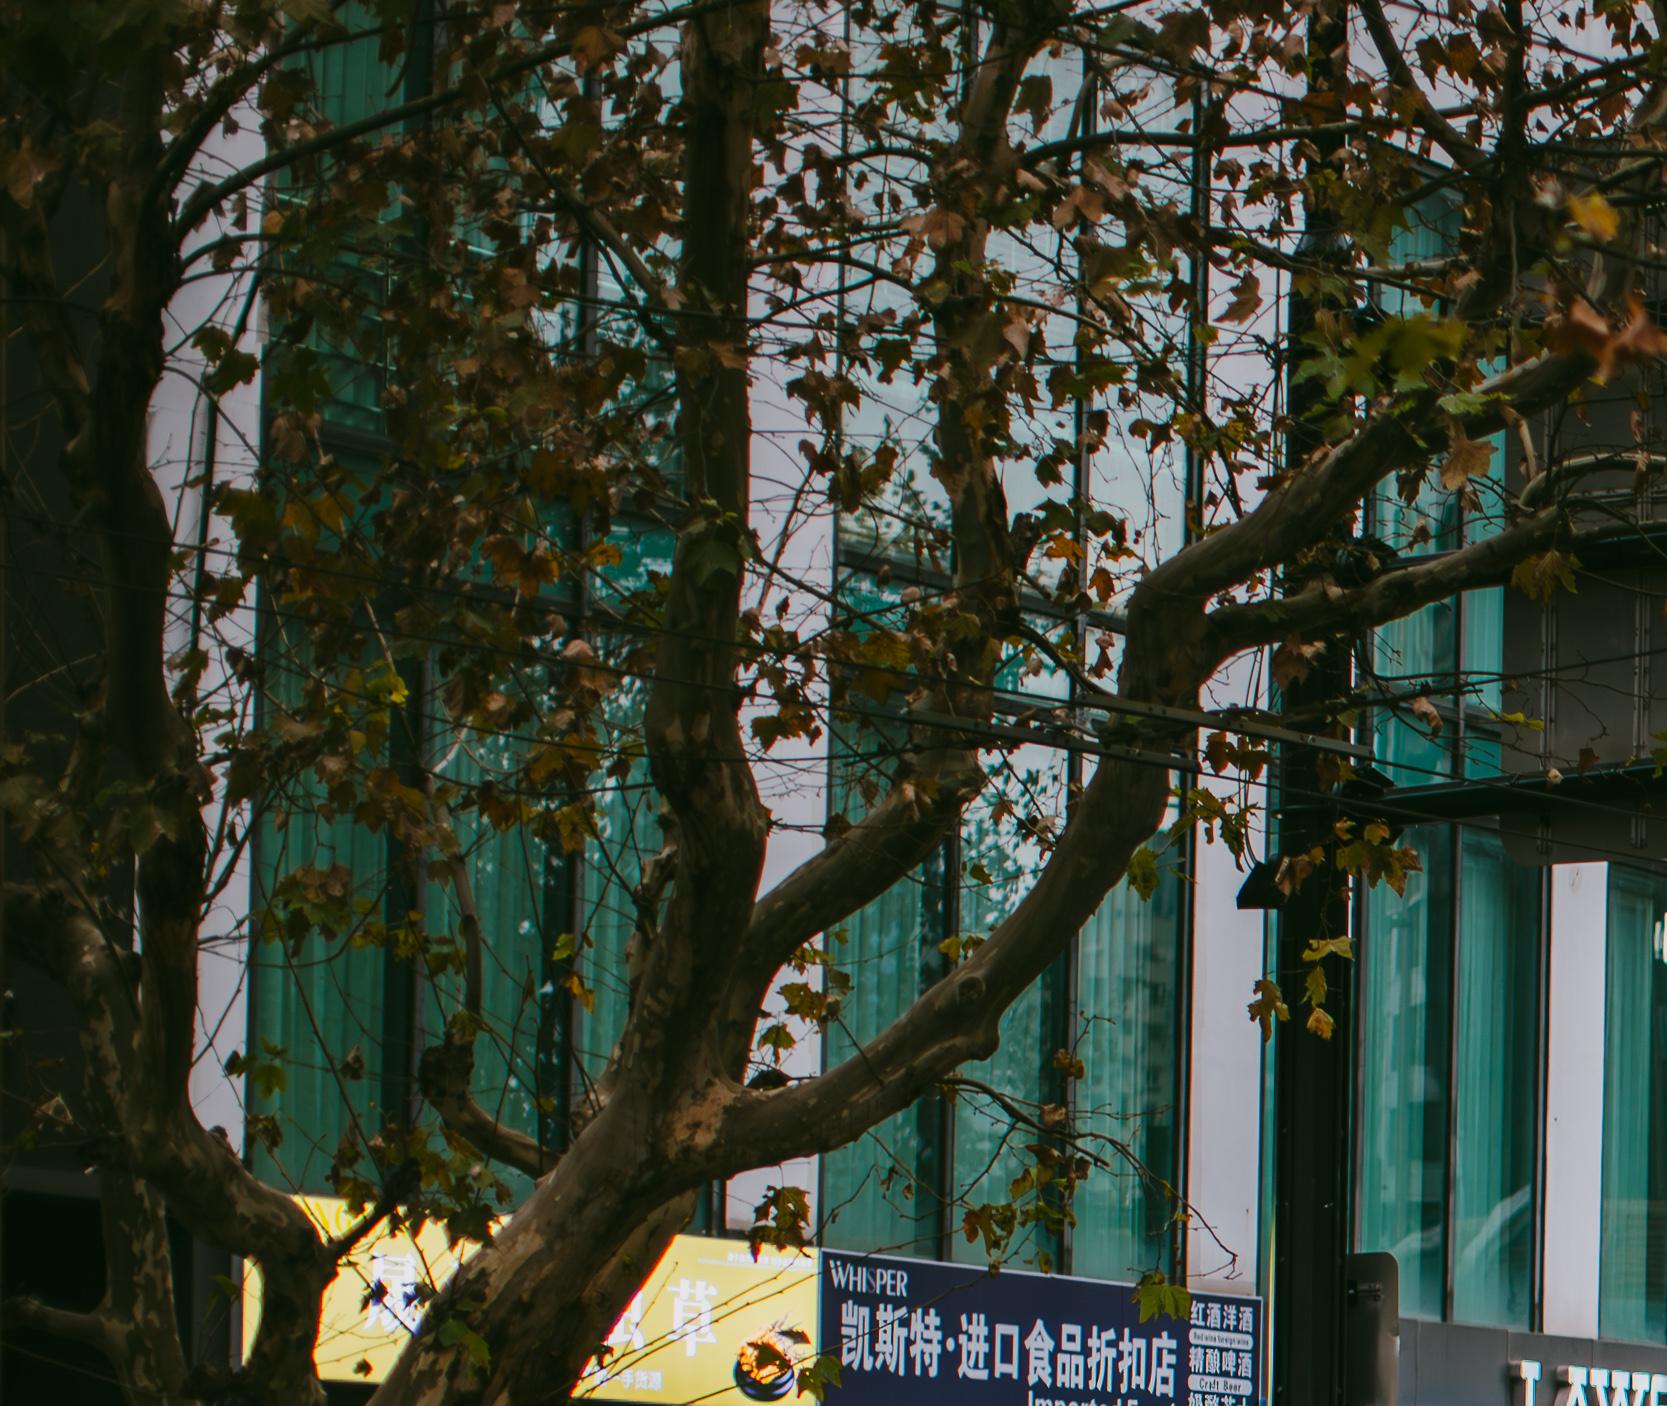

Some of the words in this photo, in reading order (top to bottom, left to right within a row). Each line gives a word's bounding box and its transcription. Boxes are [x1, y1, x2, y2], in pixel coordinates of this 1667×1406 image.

[1190, 1300, 1253, 1332] 红酒洋酒
[840, 1299, 1177, 1398] 凯斯特·进口食品折扣店
[1189, 1347, 1253, 1378] 精酿啤酒
